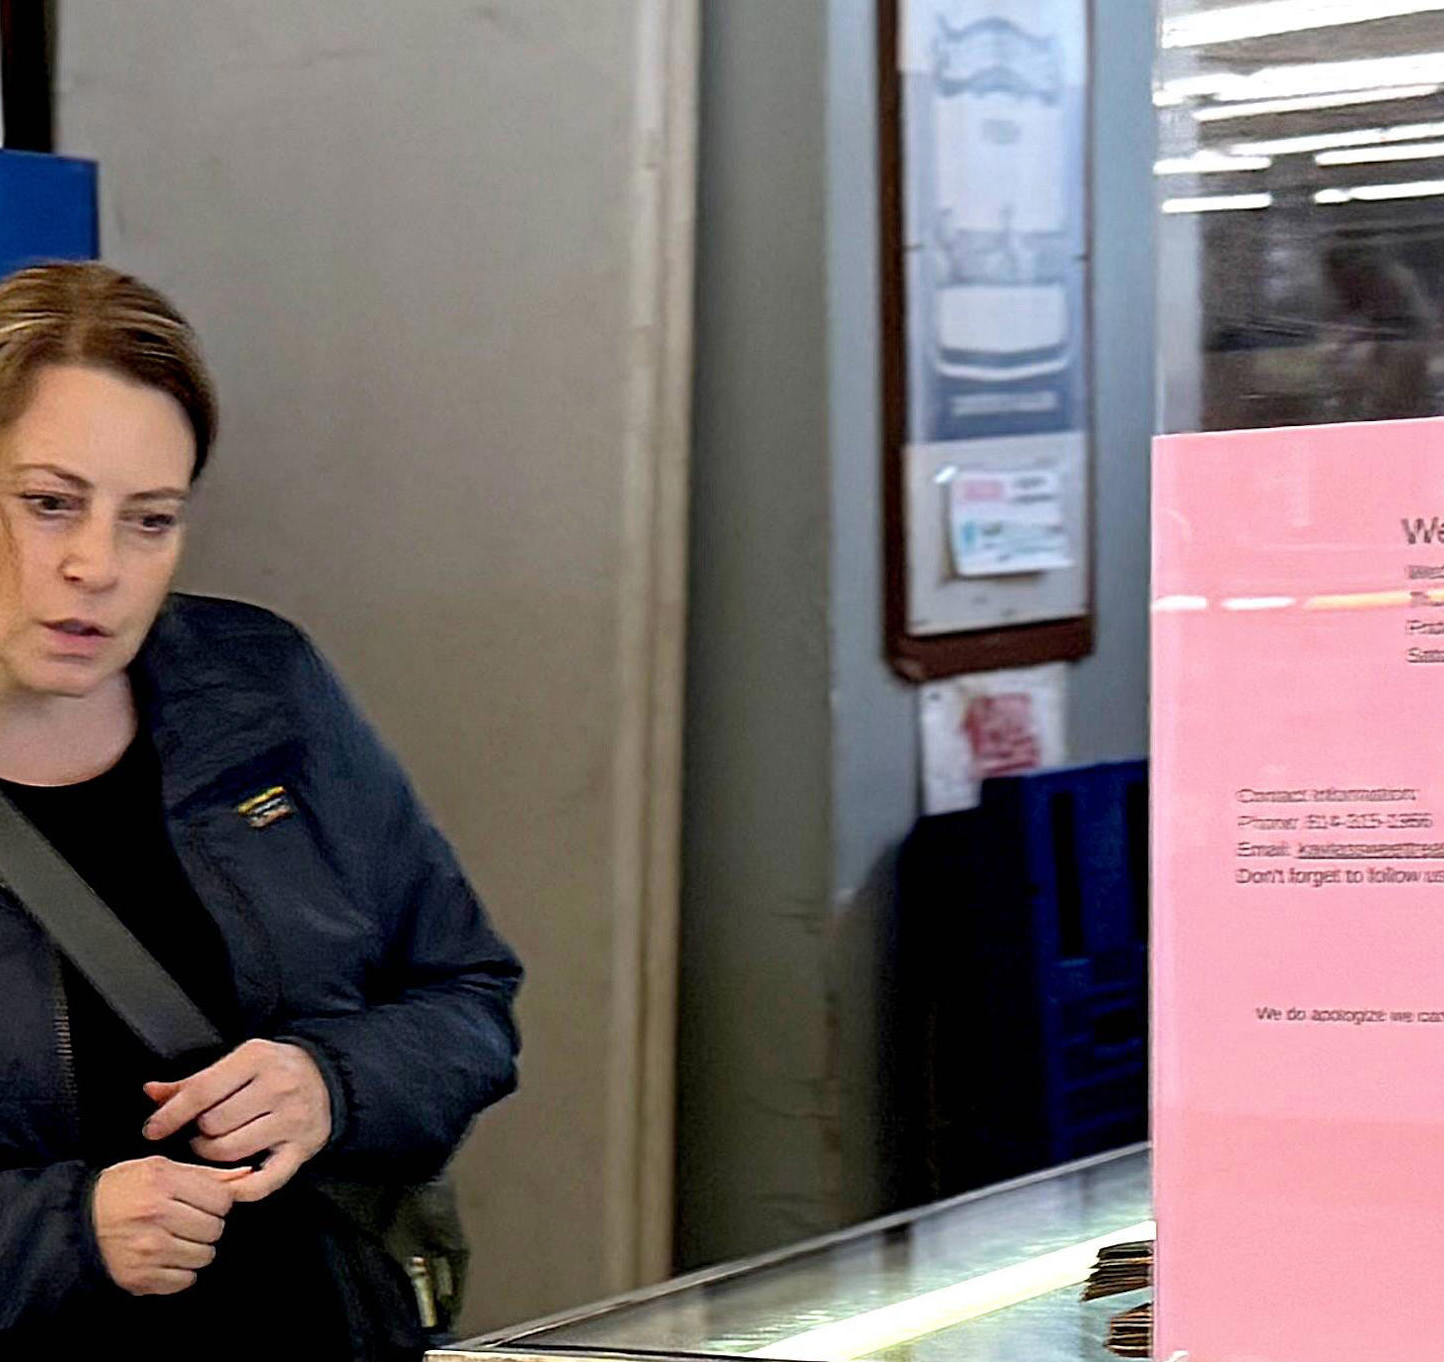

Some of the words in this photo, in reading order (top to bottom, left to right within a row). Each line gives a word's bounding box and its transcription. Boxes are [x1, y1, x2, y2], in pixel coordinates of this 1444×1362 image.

[1288, 866, 1342, 887] forget
[1345, 867, 1363, 883] to
[1367, 865, 1419, 884] follow
[1255, 1006, 1282, 1021] We
[1286, 1006, 1306, 1021] do
[1310, 1006, 1387, 1026] apologize
